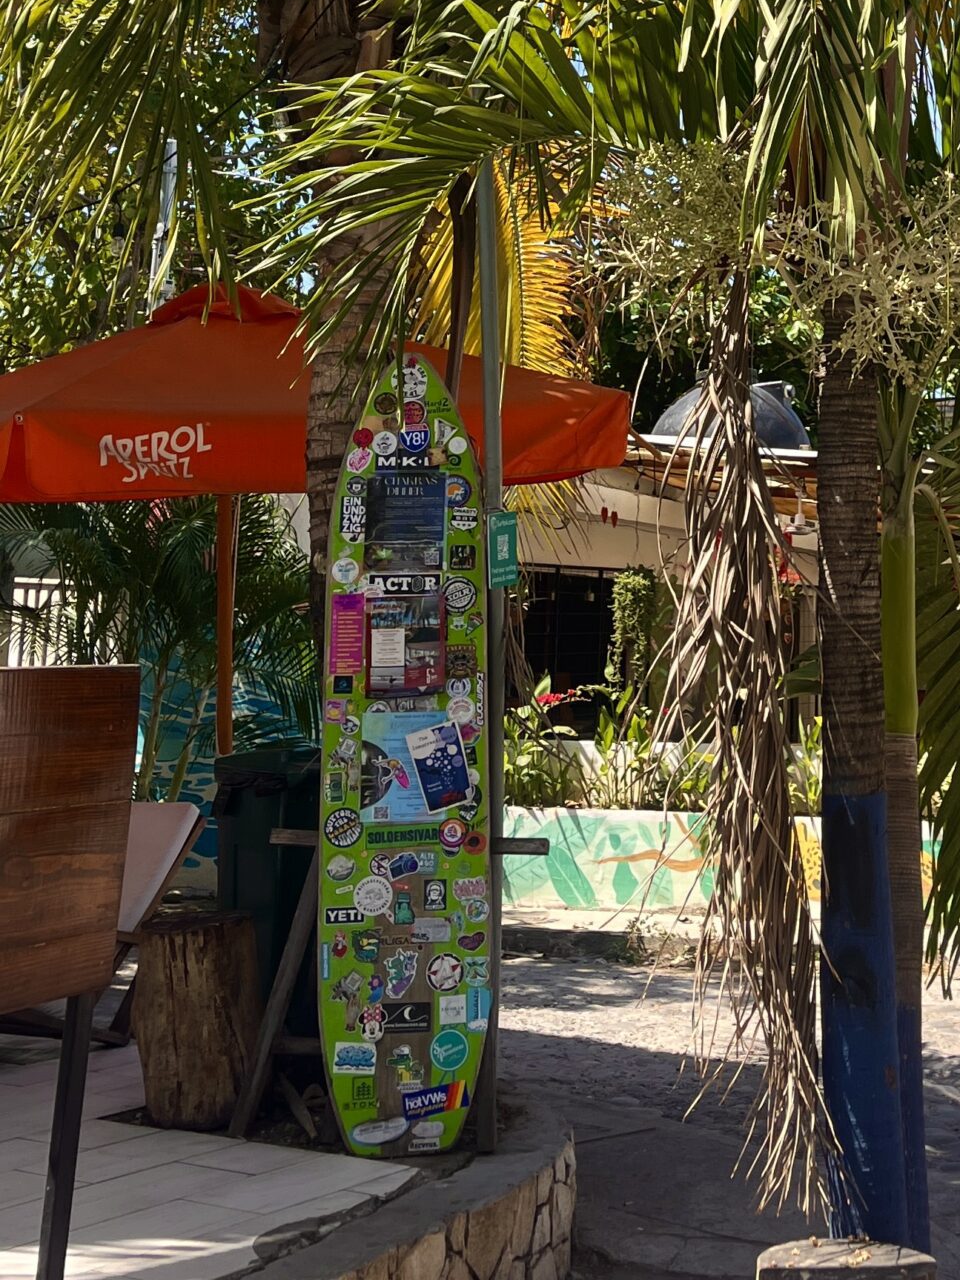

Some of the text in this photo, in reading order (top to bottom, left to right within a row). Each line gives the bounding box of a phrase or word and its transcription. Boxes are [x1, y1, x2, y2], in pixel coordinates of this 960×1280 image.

[99, 423, 212, 467] APEROL
[403, 432, 425, 446] Y8!
[343, 497, 361, 506] EIN
[343, 506, 366, 514] UND
[327, 909, 362, 922] YETI
